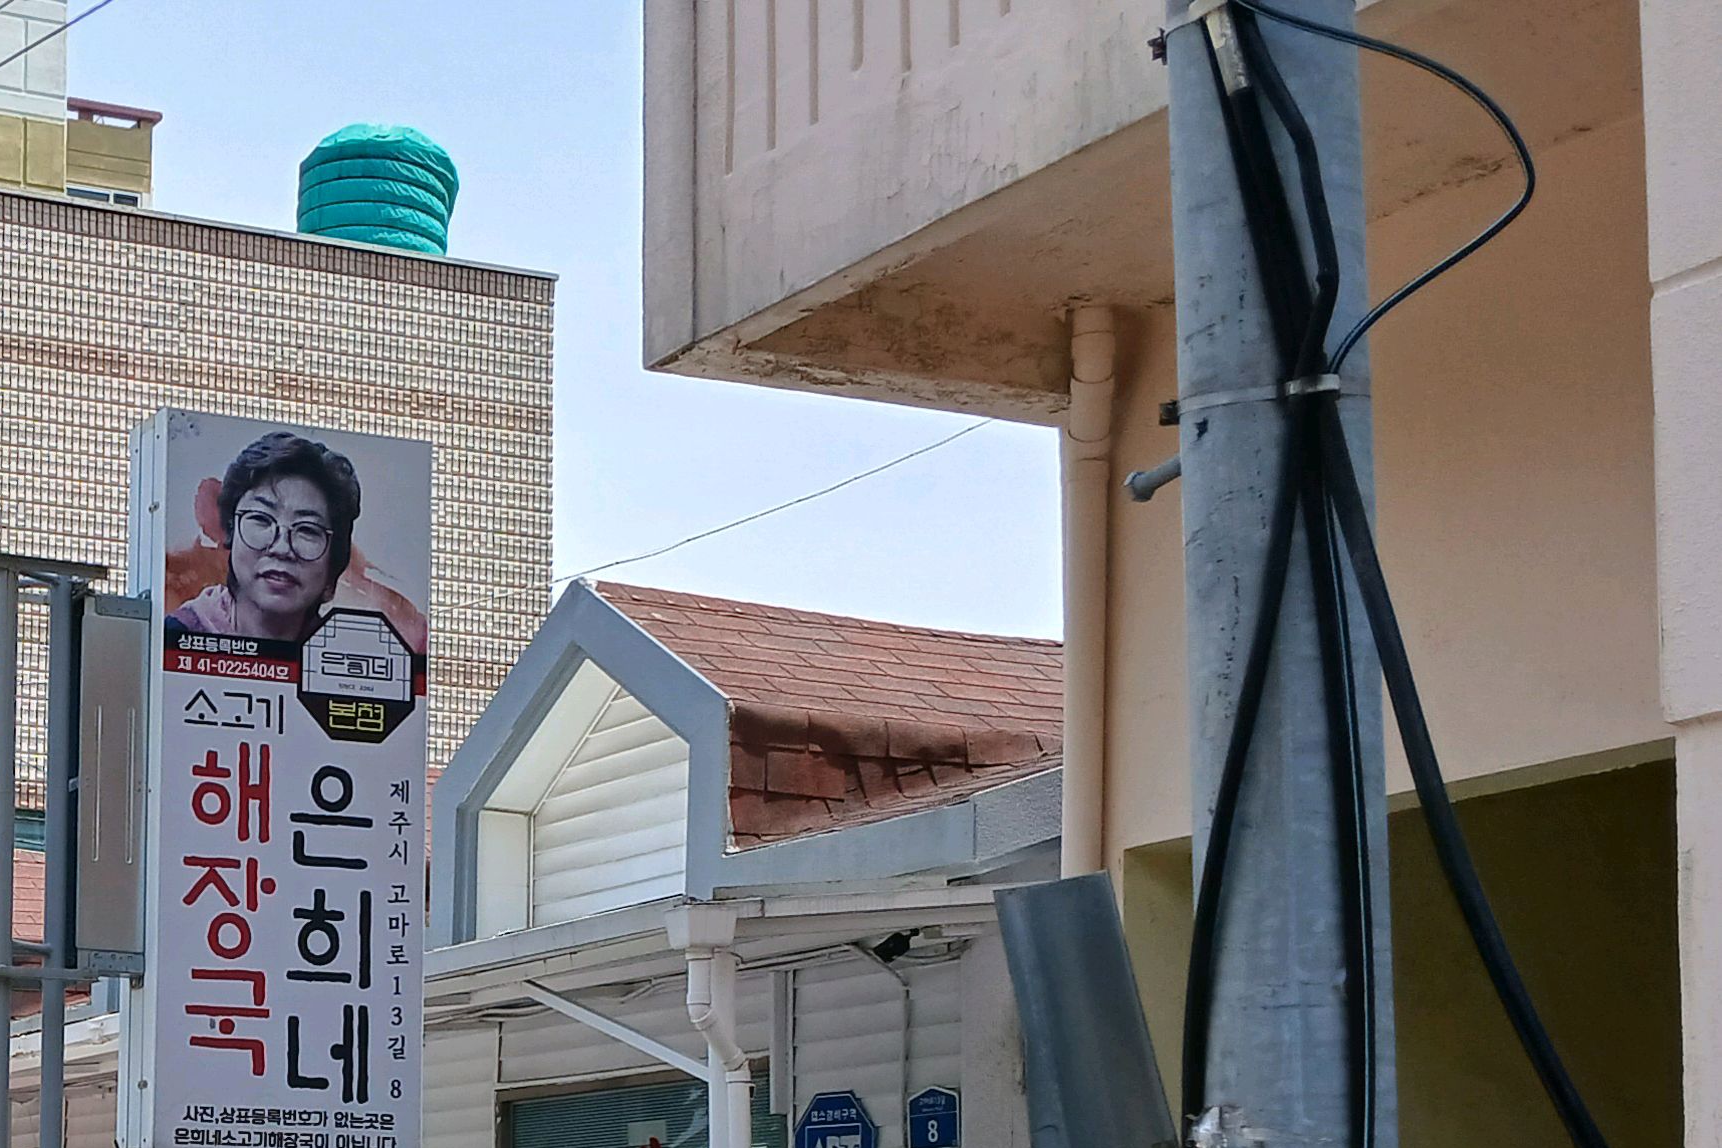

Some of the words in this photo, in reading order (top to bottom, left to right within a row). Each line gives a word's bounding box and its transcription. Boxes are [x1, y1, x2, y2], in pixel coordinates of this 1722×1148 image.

[178, 634, 259, 656] 상표등록번호
[178, 656, 192, 671] 제
[197, 658, 289, 680] 41-0225404호
[183, 688, 285, 735] 소고기
[328, 700, 384, 732] 본점
[387, 779, 412, 866] 제주시
[182, 742, 276, 1077] 해장국
[286, 764, 374, 1104] 은희네
[389, 1079, 403, 1099] 8
[333, 1111, 395, 1131] 없는곳은
[927, 1119, 939, 1143] 8
